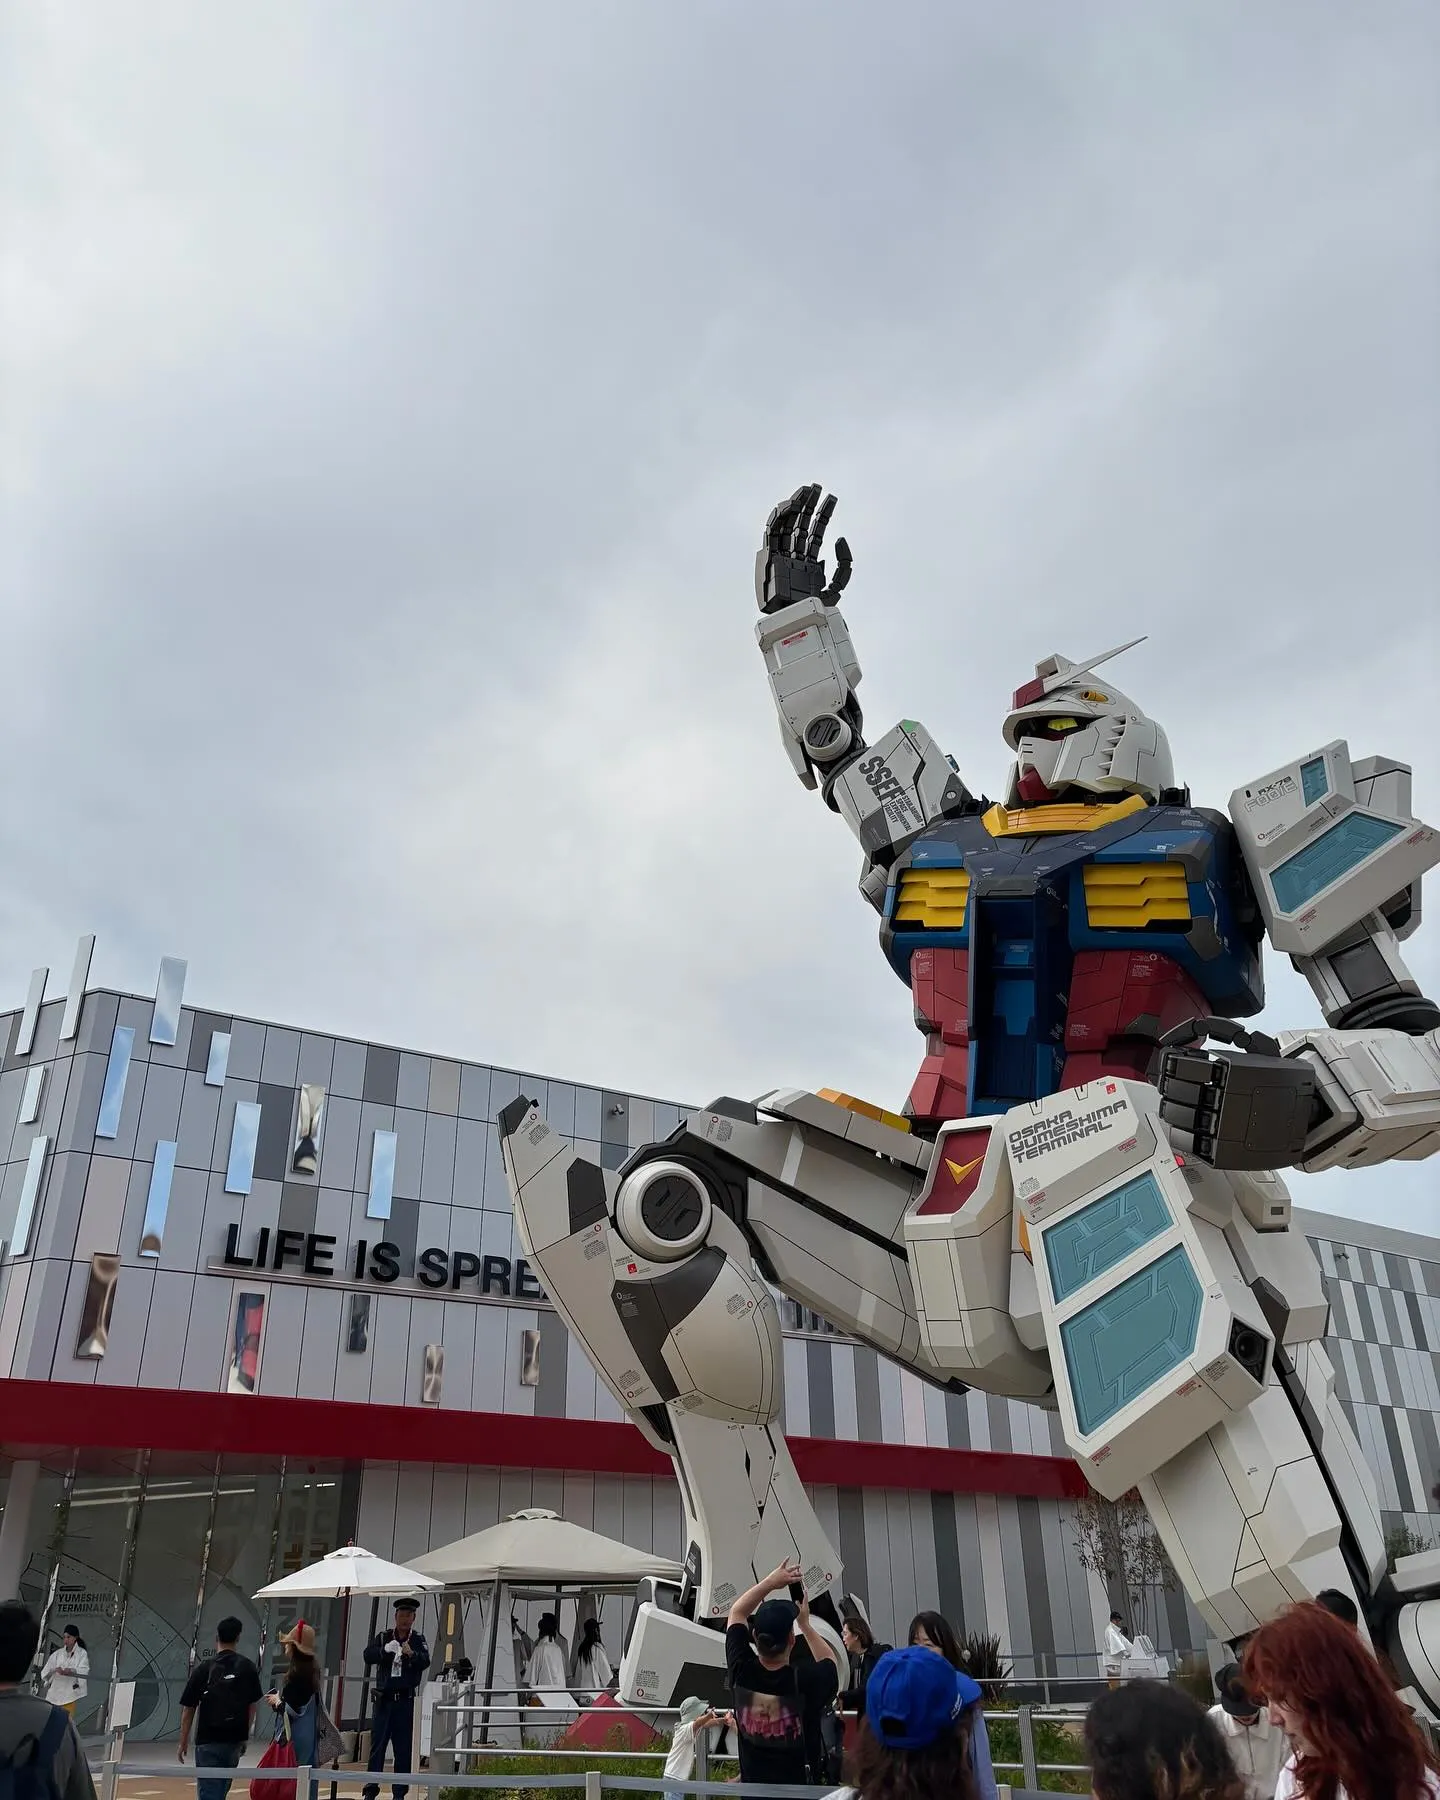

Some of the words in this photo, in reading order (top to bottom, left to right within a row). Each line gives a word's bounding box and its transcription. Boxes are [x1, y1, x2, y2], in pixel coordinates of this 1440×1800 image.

[1258, 775, 1292, 795] RX-78
[1008, 1110, 1073, 1143] OSAKA
[1011, 1099, 1128, 1155] YUMESHIMA
[1013, 1121, 1113, 1164] TERMINAL
[225, 1223, 337, 1275] LIFE
[355, 1239, 401, 1282] IS
[418, 1247, 550, 1299] SPRE
[58, 1603, 105, 1612] TERMINAL
